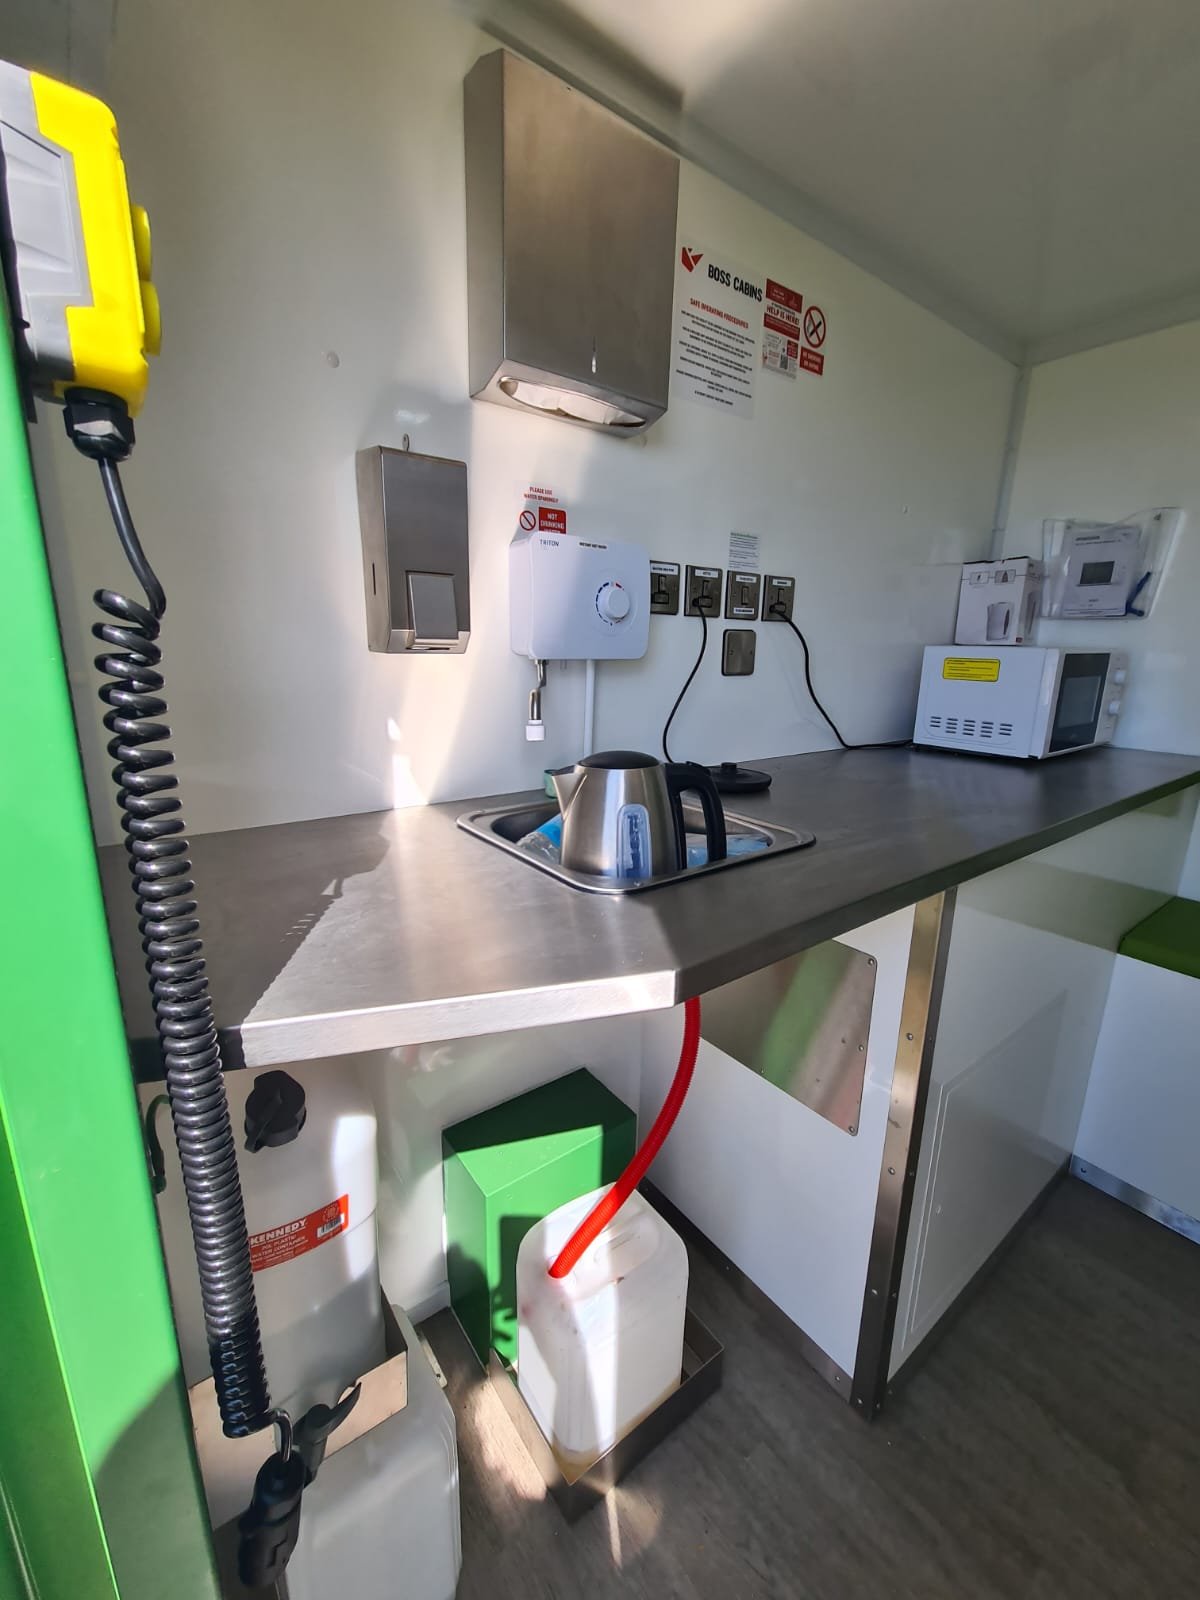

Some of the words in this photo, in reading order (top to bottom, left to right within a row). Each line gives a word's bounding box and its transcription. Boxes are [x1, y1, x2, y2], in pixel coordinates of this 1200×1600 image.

[708, 264, 731, 287] BOSS
[733, 276, 763, 303] CABINS
[690, 298, 701, 309] SAFE
[701, 302, 724, 319] OPERATING
[723, 312, 749, 329] PROCEDURES
[766, 304, 779, 316] HELP
[529, 486, 544, 494] PLEASE
[540, 520, 565, 529] DRINKING
[540, 539, 560, 547] TRITON
[250, 1218, 307, 1245] KENNEDY
